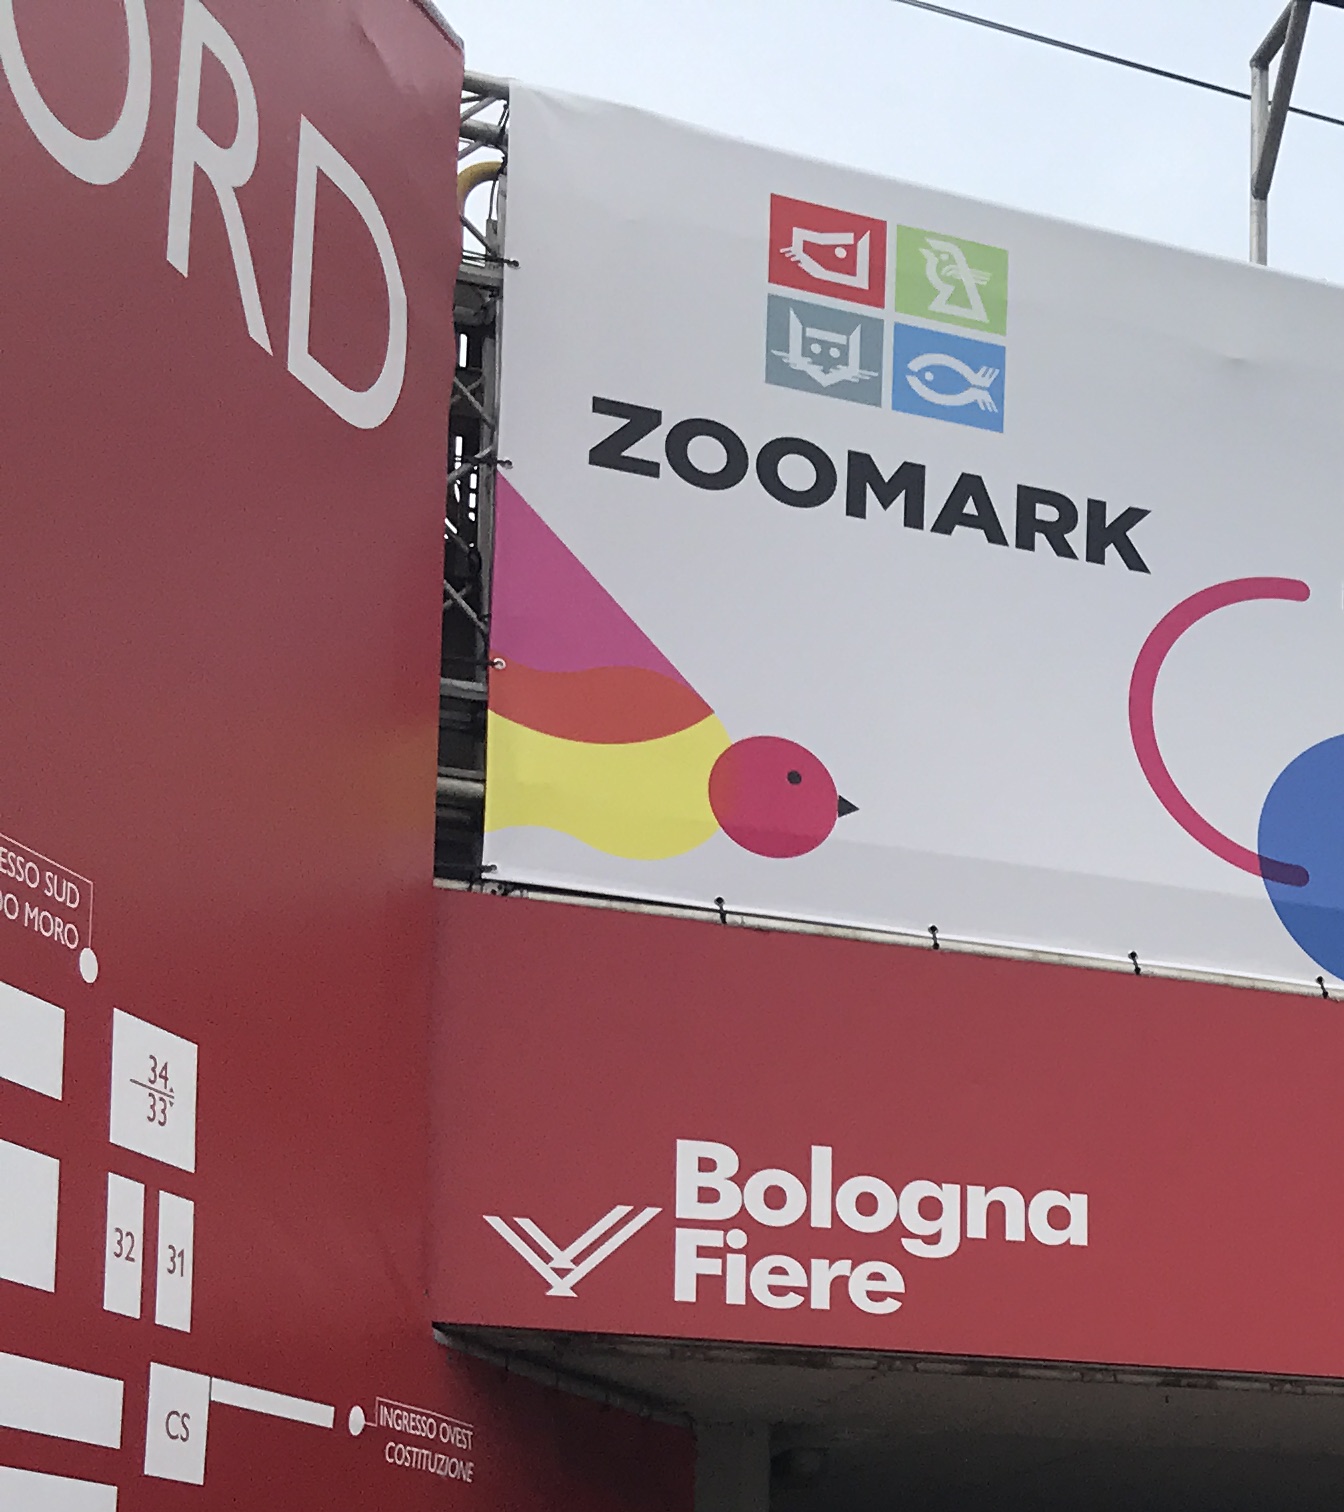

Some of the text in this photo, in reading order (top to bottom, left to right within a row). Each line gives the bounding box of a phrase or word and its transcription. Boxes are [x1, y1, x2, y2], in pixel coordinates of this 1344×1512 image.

[588, 396, 1151, 574] ZOOMARK
[44, 871, 80, 909] SUD
[24, 901, 79, 949] MORO
[148, 1054, 170, 1089] 34
[147, 1092, 168, 1127] 33
[675, 1138, 1088, 1258] Bologna
[113, 1227, 136, 1263] 32
[166, 1244, 185, 1278] 31
[673, 1227, 906, 1315] Fiere
[165, 1410, 191, 1443] CS
[379, 1405, 474, 1450] INGRESSO OVEST
[385, 1441, 474, 1483] COSTITUZIONE
